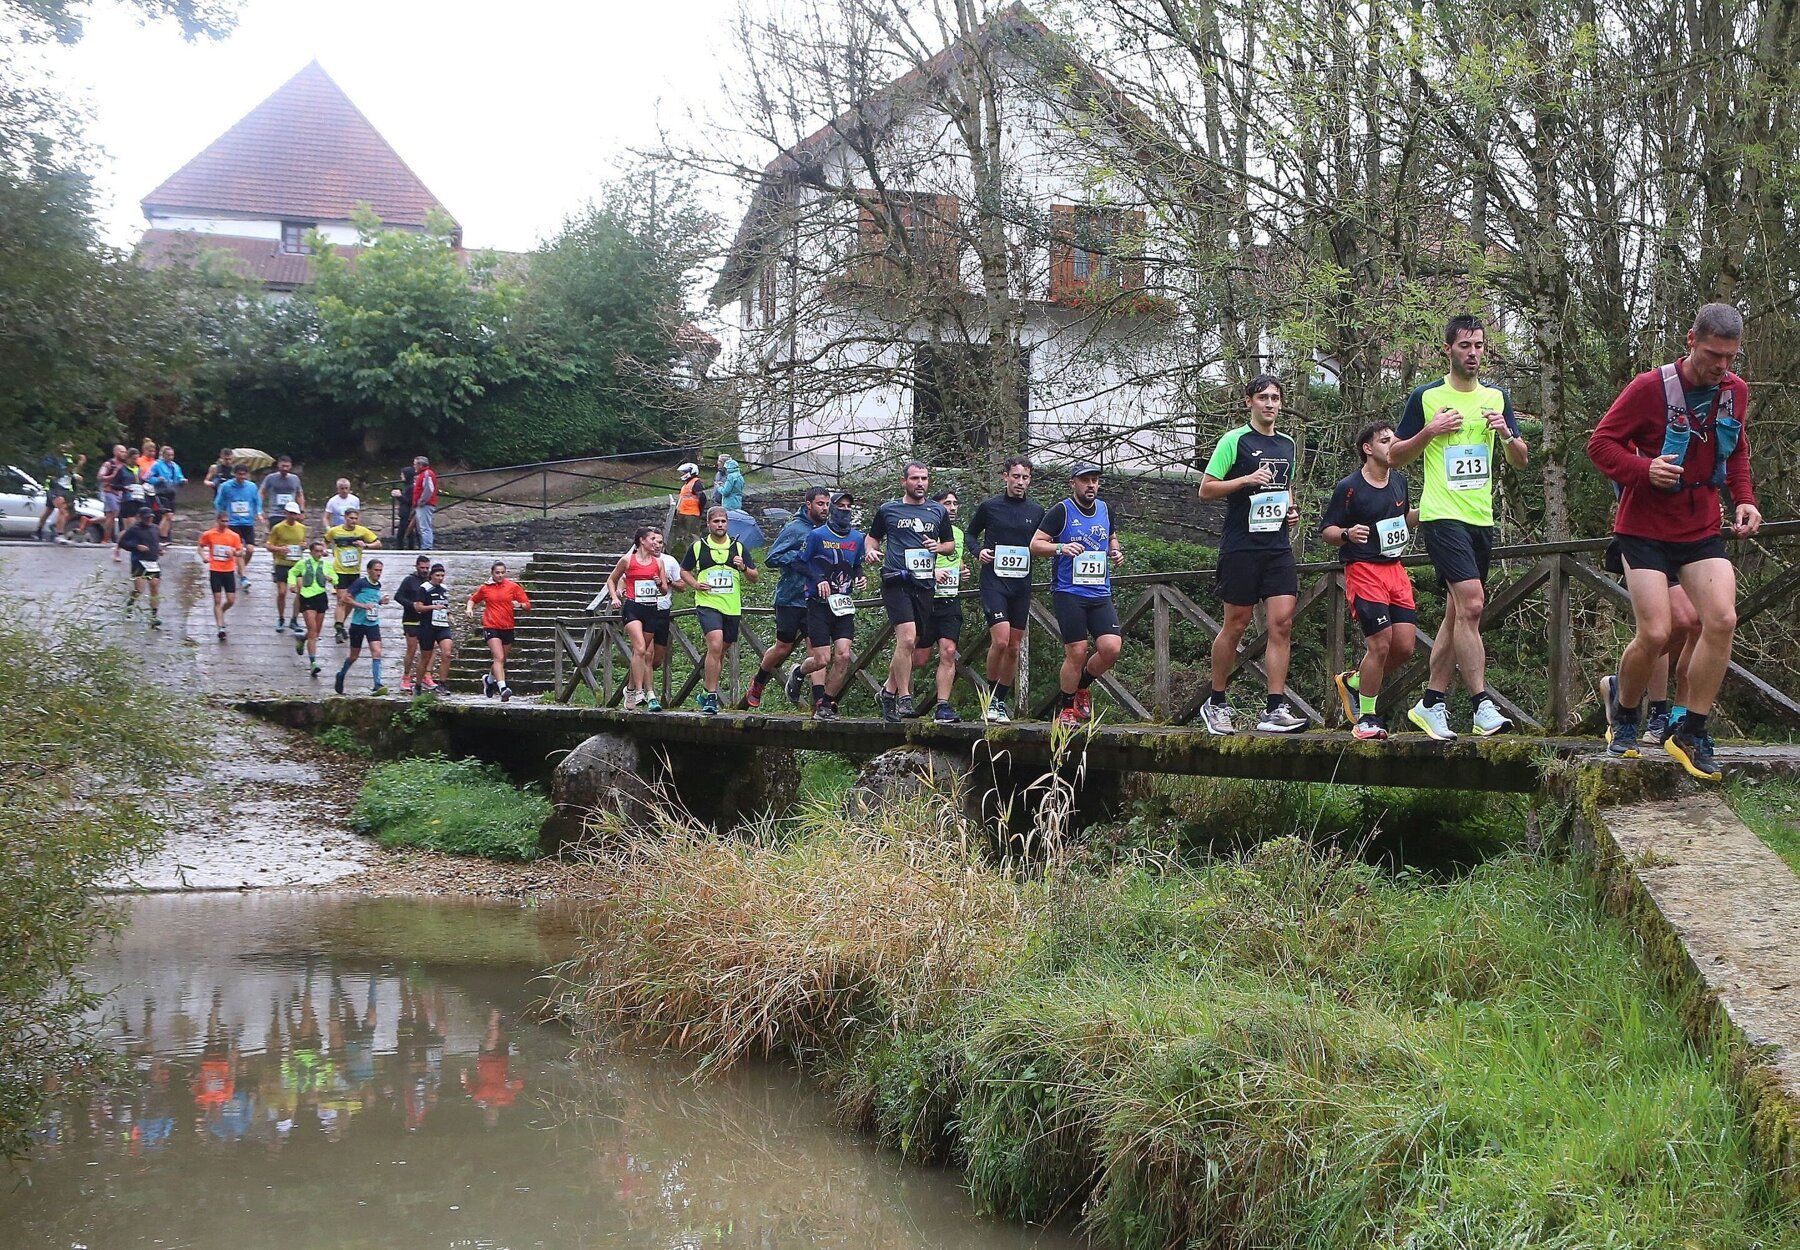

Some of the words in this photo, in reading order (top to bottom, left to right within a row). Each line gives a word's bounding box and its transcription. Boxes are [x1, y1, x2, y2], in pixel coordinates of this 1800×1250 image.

[1456, 459, 1482, 475] 213
[1257, 505, 1282, 518] 436
[1387, 529, 1405, 545] 896
[912, 558, 931, 568] 948
[1001, 556, 1023, 567] 897
[1081, 562, 1101, 573] 751
[713, 577, 728, 586] 177
[833, 596, 852, 608] 1068
